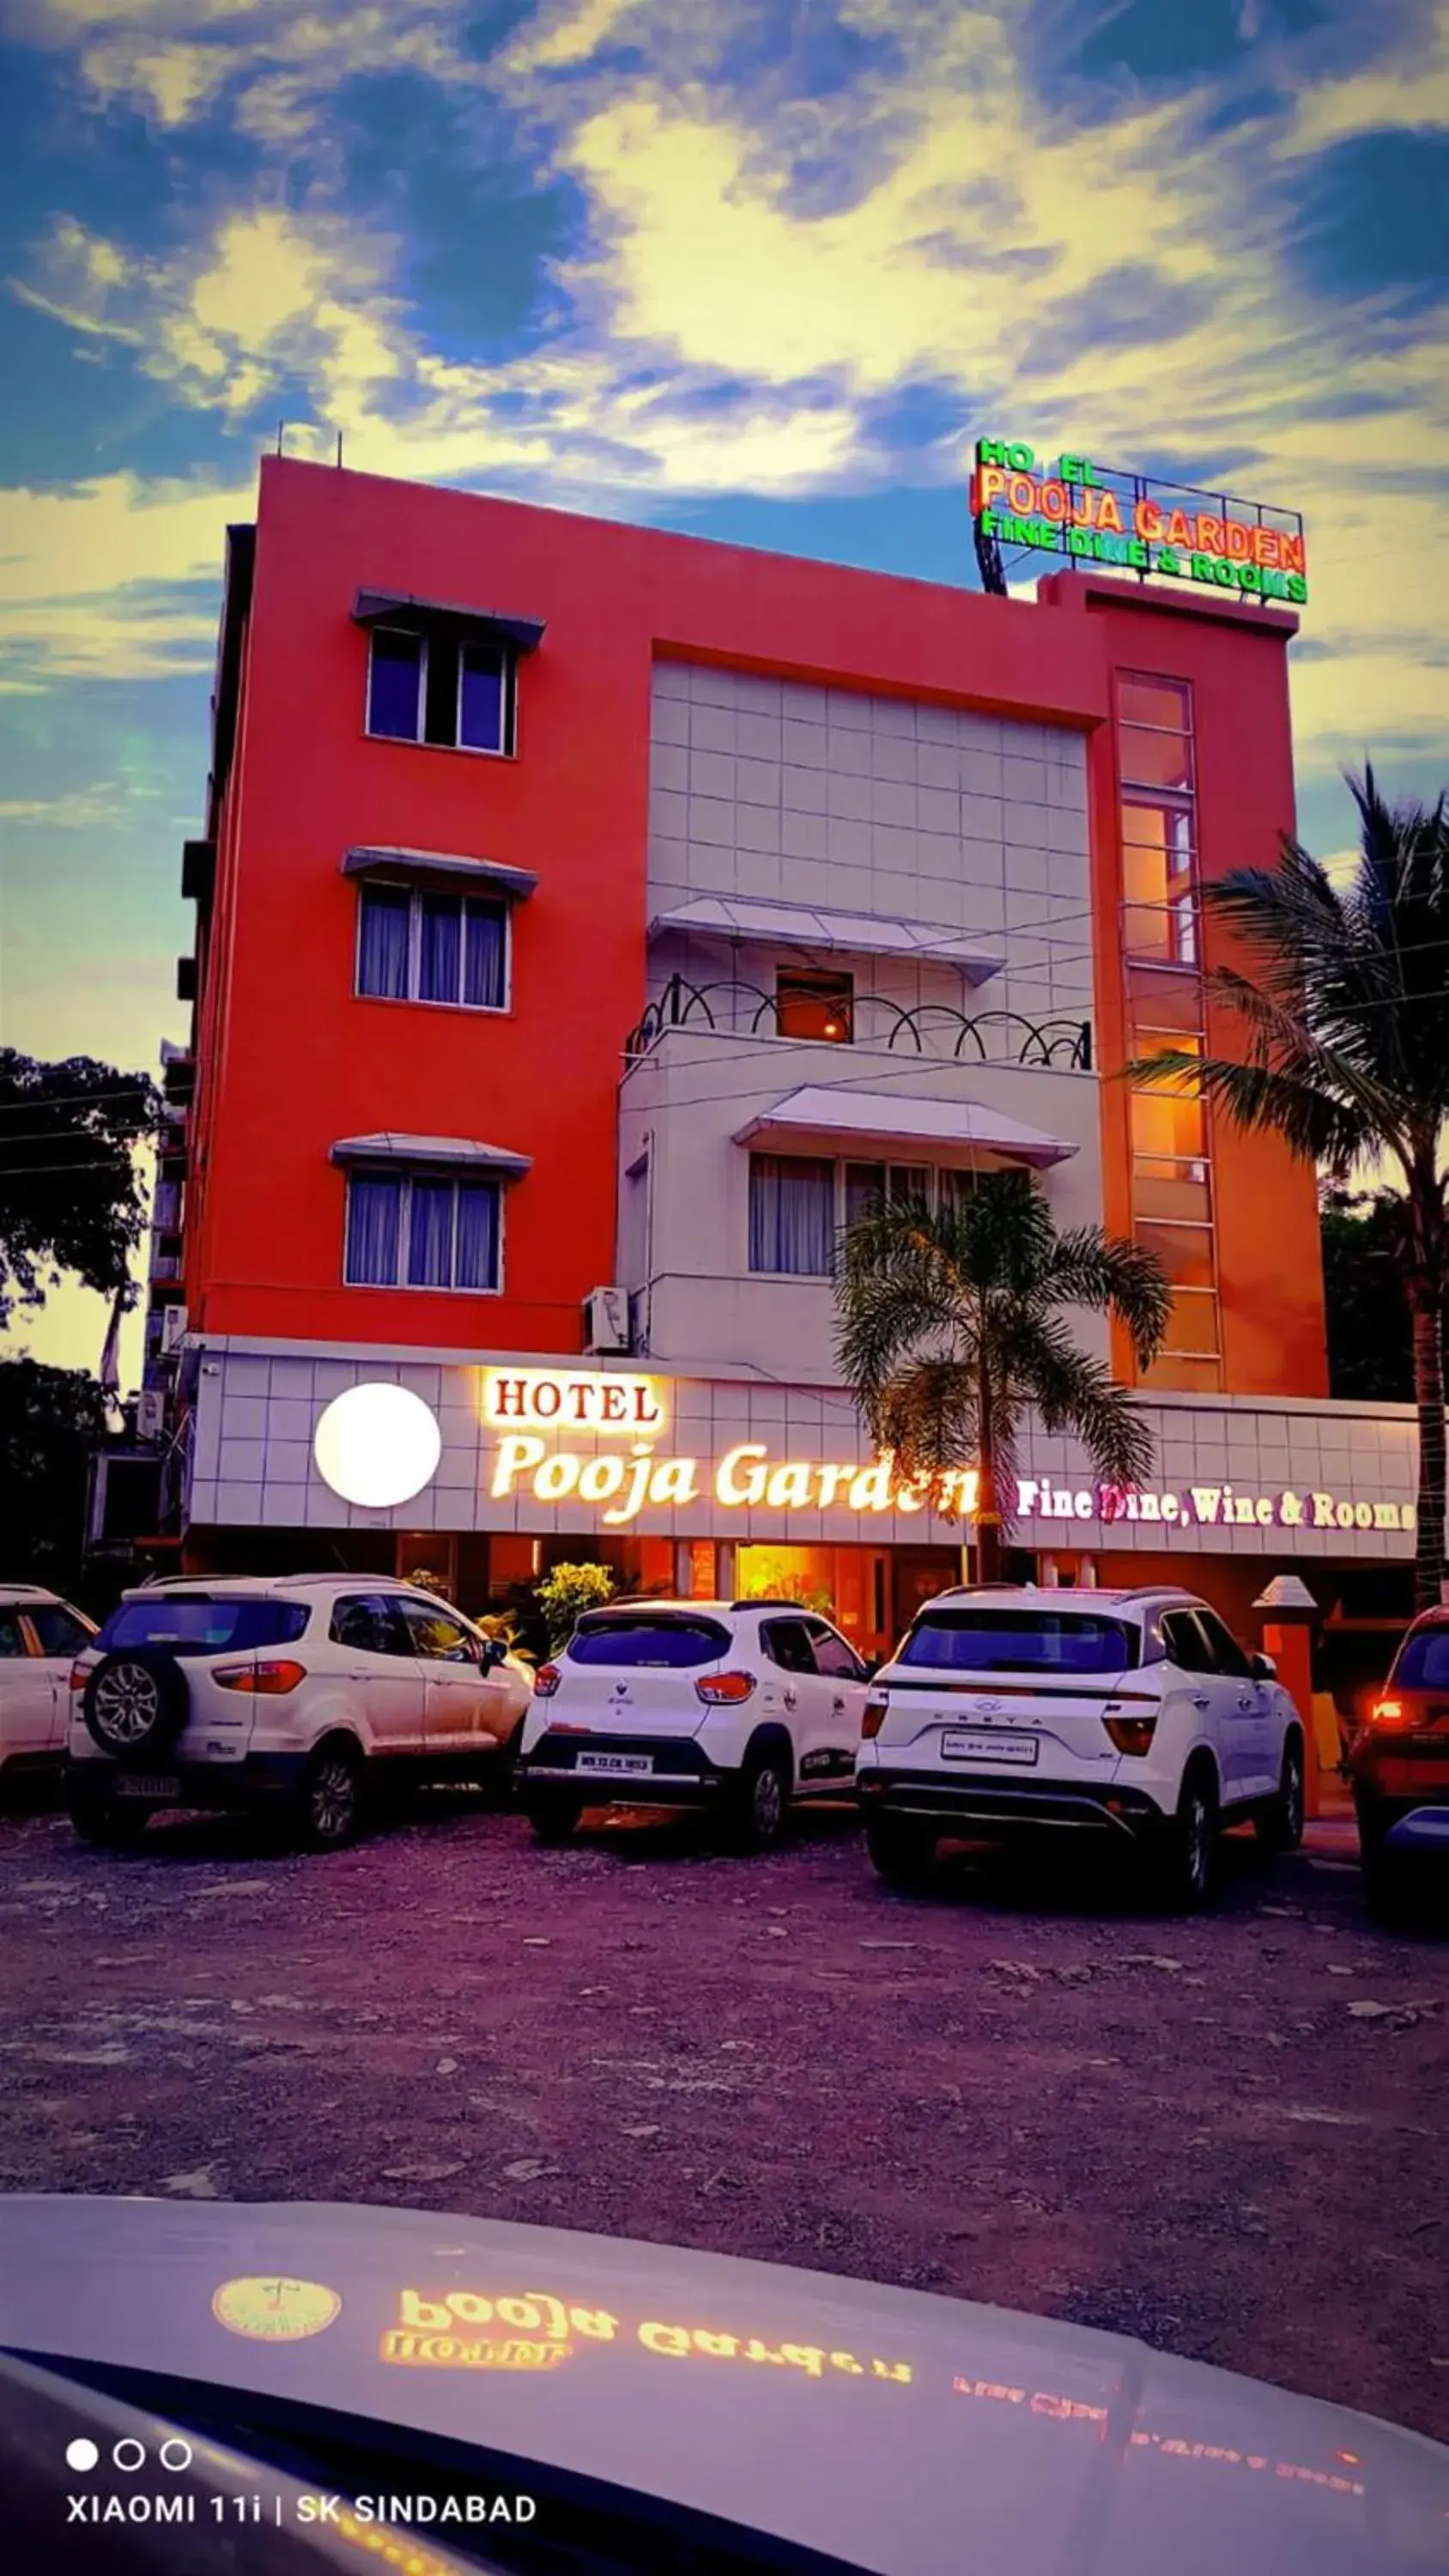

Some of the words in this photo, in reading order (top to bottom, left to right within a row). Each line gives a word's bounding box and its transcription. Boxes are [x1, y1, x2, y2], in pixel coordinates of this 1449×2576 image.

[977, 464, 1124, 534] POOJA
[1134, 498, 1307, 574] GARDEN
[981, 510, 1058, 548] FINE
[1070, 526, 1148, 570] DINE
[1157, 545, 1181, 577] &
[1191, 551, 1308, 605] ROOMS
[495, 1379, 659, 1422] HOTEL
[490, 1435, 700, 1524] Pooja
[716, 1444, 980, 1515] Garden
[1016, 1478, 1094, 1519] Fine
[1279, 1491, 1304, 1526] &
[1311, 1492, 1416, 1531] Rooms
